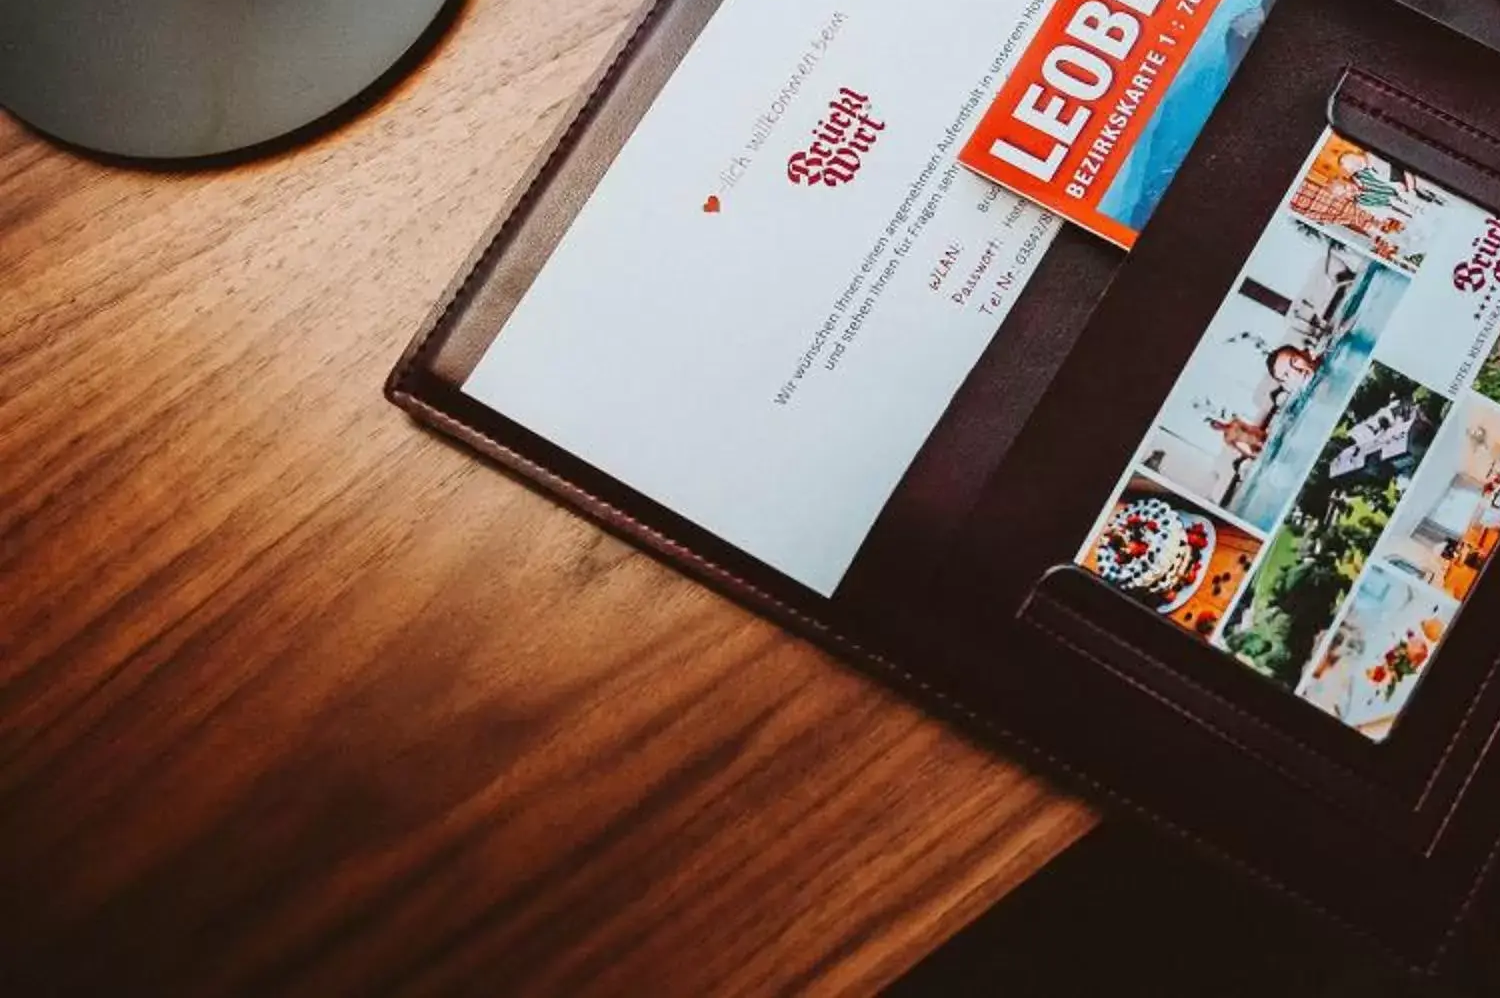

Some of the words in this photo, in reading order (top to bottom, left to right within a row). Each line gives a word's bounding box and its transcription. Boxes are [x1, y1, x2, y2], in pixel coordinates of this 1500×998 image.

[746, 52, 817, 150] willkommen
[788, 87, 869, 186] Brückl
[823, 114, 886, 187] Wirt
[1065, 50, 1166, 199] BEZIRKSKARTE
[1158, 33, 1177, 47] 1
[774, 380, 797, 406] Wir
[795, 312, 841, 379] wünschen
[833, 273, 865, 313] Ihnen
[861, 236, 889, 273] einen
[886, 152, 941, 236] angenehmen
[936, 85, 985, 152] Aufenthalt
[980, 74, 993, 93] in
[991, 19, 1029, 74] unserem
[824, 341, 846, 371] und
[841, 296, 875, 342] stehen
[869, 257, 900, 297] Ihnen
[893, 235, 912, 258] für
[907, 191, 942, 238] Fragen
